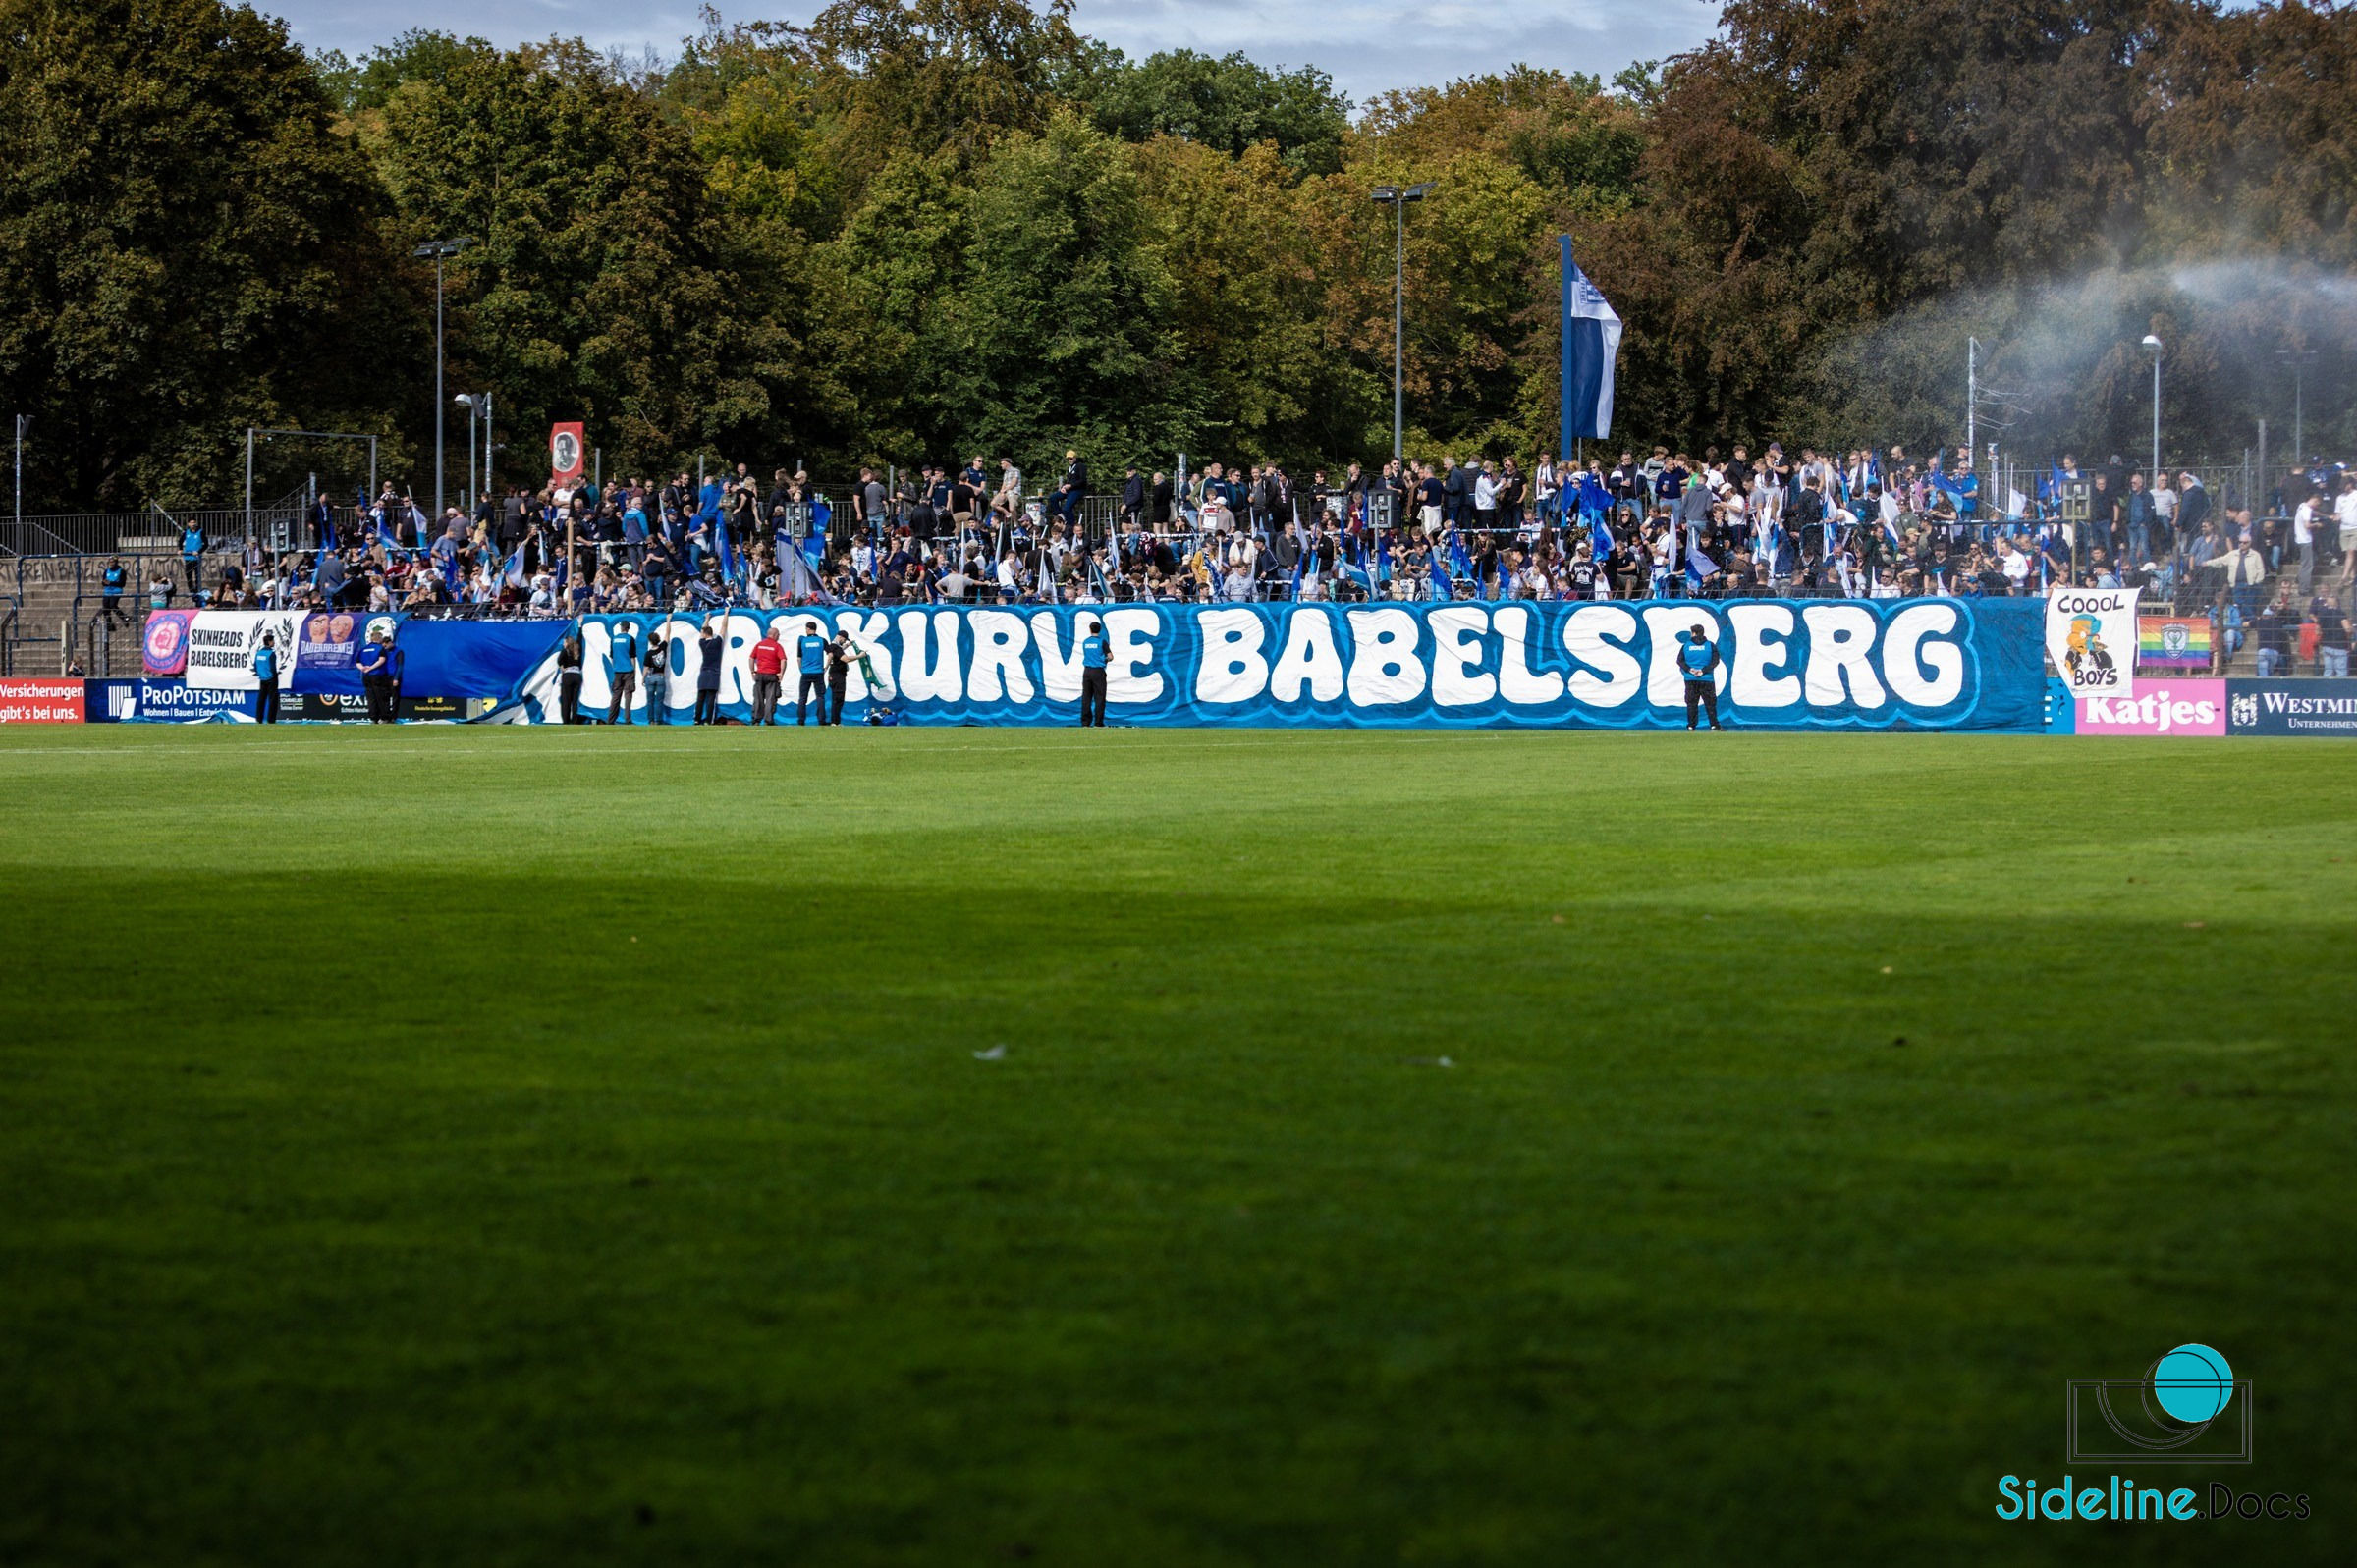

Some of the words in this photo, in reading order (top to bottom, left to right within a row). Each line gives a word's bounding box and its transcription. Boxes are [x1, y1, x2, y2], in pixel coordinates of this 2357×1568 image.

[2057, 594, 2125, 614] COOOL
[192, 628, 244, 648] SKINHEADS
[191, 650, 247, 668] BABELSBERG
[578, 610, 1164, 710] NORDKURVE
[1195, 606, 1963, 708] BABELSBERG
[2074, 668, 2118, 687] BOYS
[0, 683, 84, 700] Versicherungen
[0, 705, 30, 723] gibt's
[33, 705, 50, 719] bei
[53, 707, 78, 719] uns.
[143, 708, 171, 717] Wohnen
[174, 708, 195, 717] Bauen
[2086, 690, 2216, 732] Katjes
